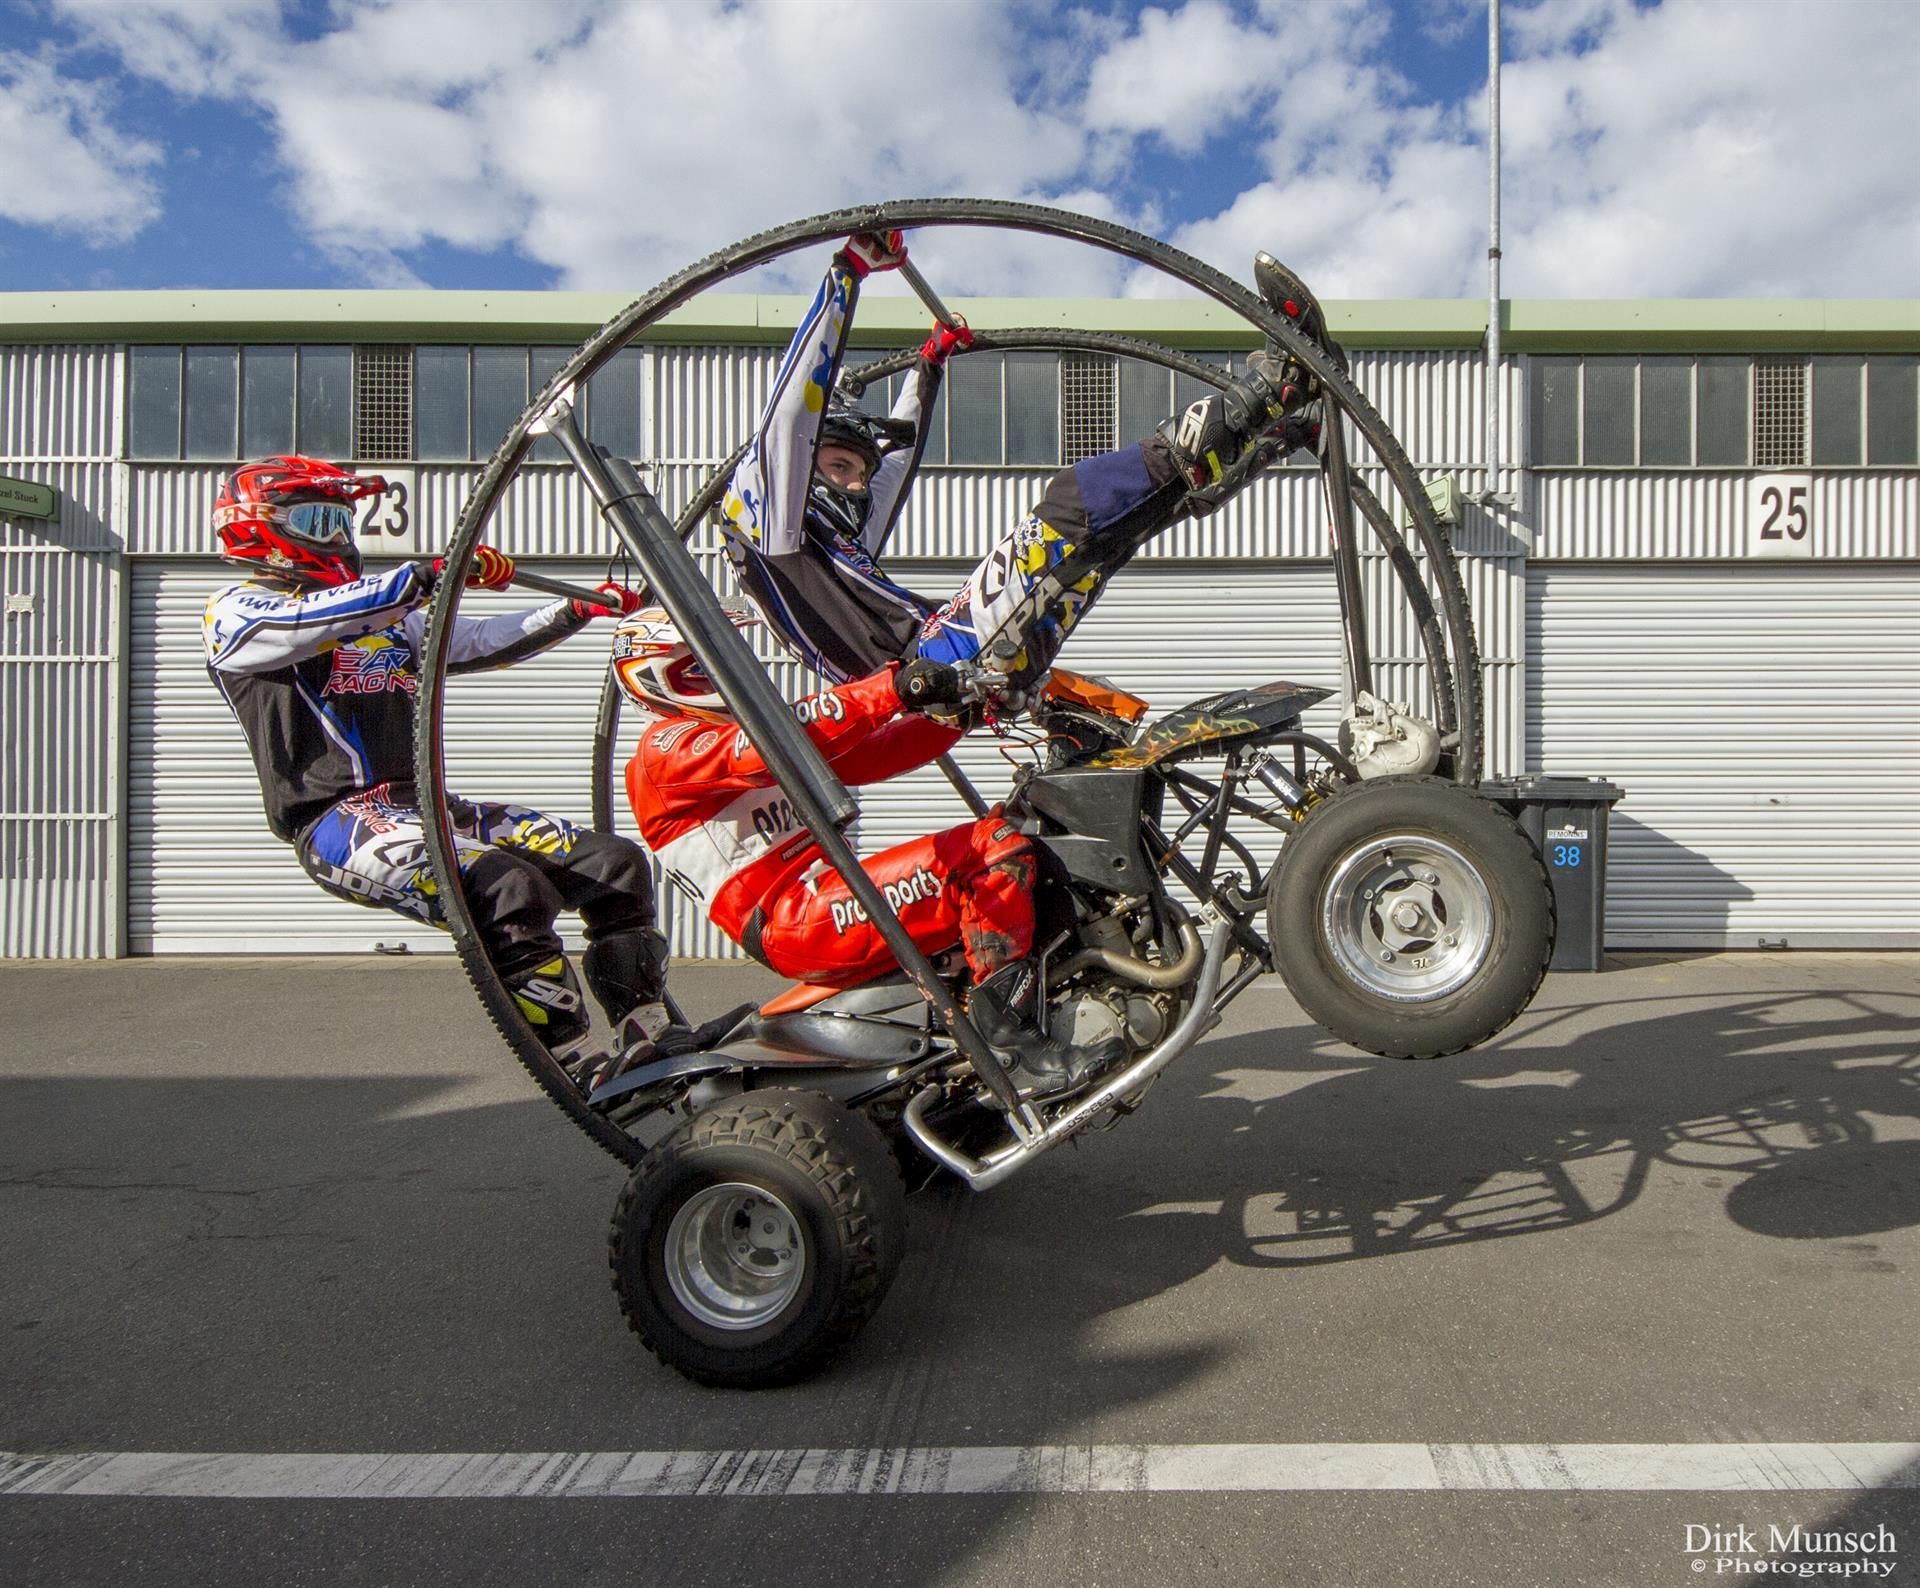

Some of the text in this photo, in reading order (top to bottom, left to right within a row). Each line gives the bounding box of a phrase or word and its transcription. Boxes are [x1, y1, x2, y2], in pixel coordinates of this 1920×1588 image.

[359, 481, 410, 537] 23
[1760, 486, 1808, 541] 25
[1553, 845, 1581, 867] 38
